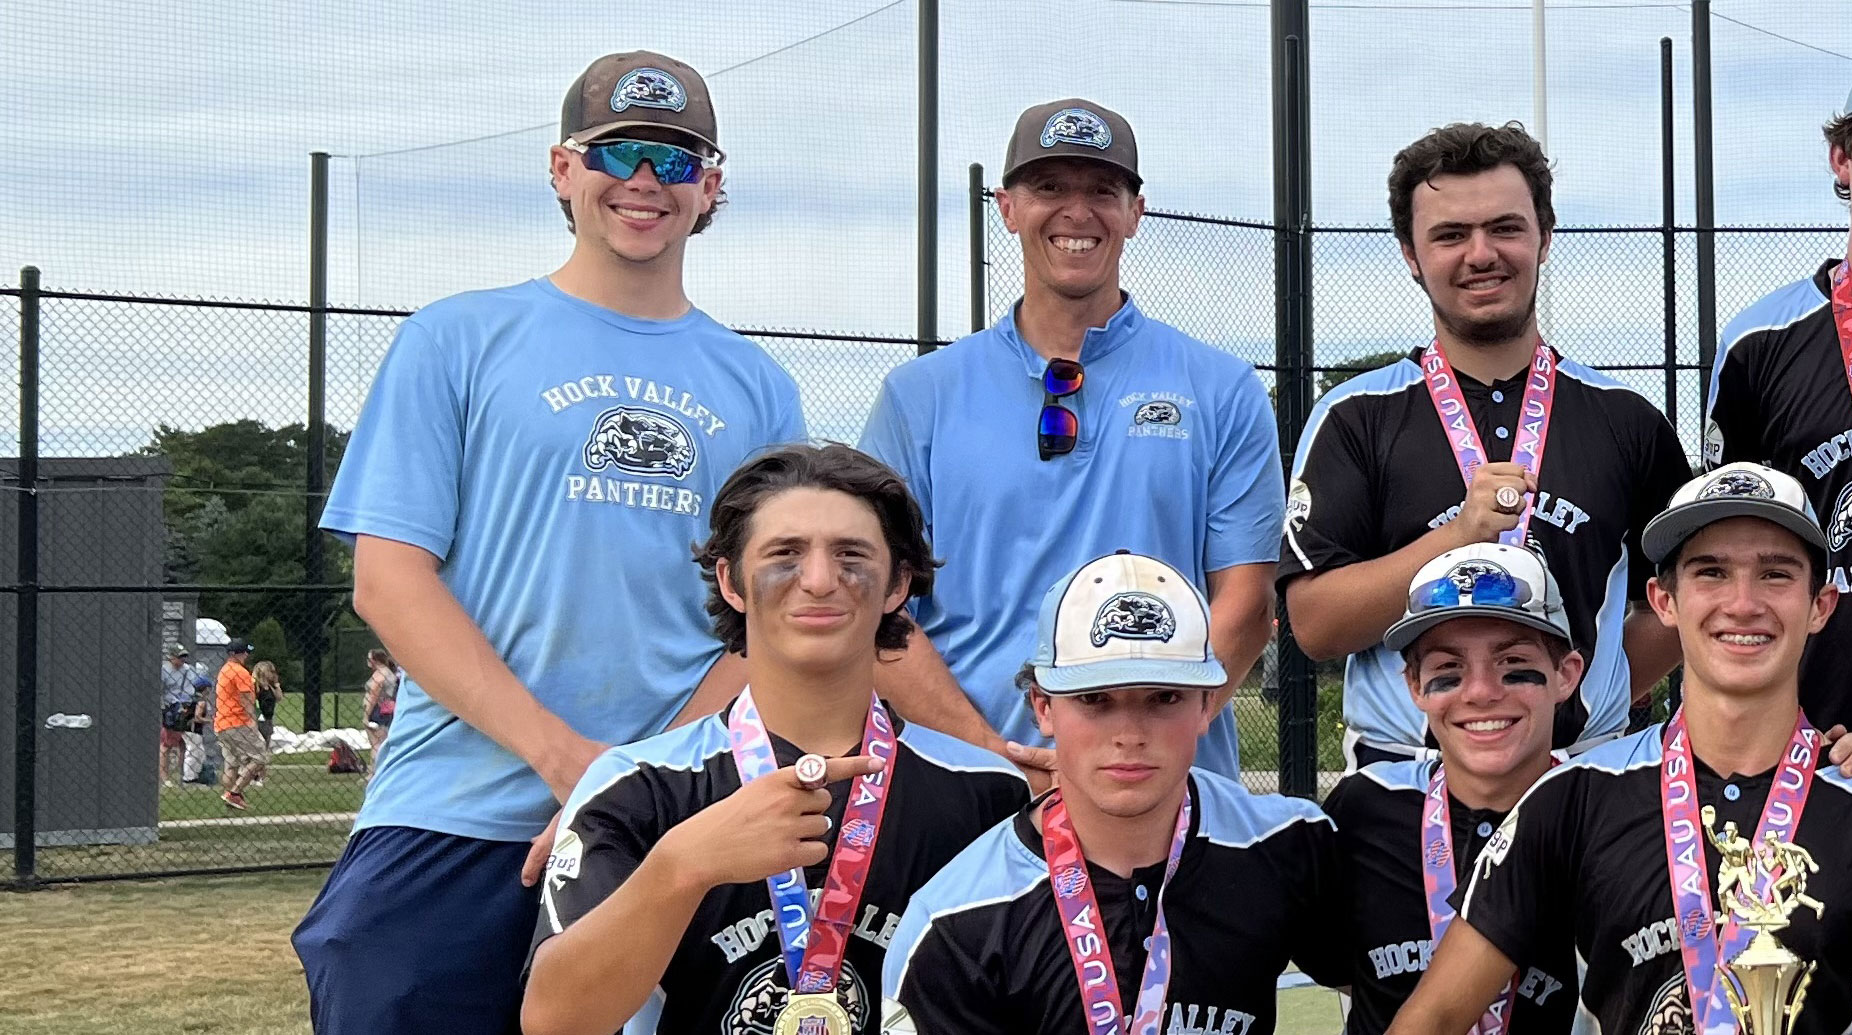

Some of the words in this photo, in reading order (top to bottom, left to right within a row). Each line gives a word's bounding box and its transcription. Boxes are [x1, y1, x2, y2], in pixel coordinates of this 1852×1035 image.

[1425, 340, 1450, 392] USA
[1532, 345, 1552, 391] USA
[541, 375, 618, 412] HOCK
[624, 376, 726, 438] VALLEY
[1119, 392, 1146, 408] HOCK
[1151, 391, 1194, 408] VALLEY
[1439, 398, 1477, 451] AAU
[1128, 426, 1189, 440] PANTHERS
[1520, 399, 1545, 457] AAU
[567, 475, 703, 516] PANTHERS
[1668, 730, 1690, 805] USA
[1780, 728, 1816, 790] USA
[1671, 818, 1702, 896] AAU
[711, 909, 776, 963] HOC
[1072, 904, 1107, 986] USA
[1165, 1002, 1256, 1035] ALLEY
